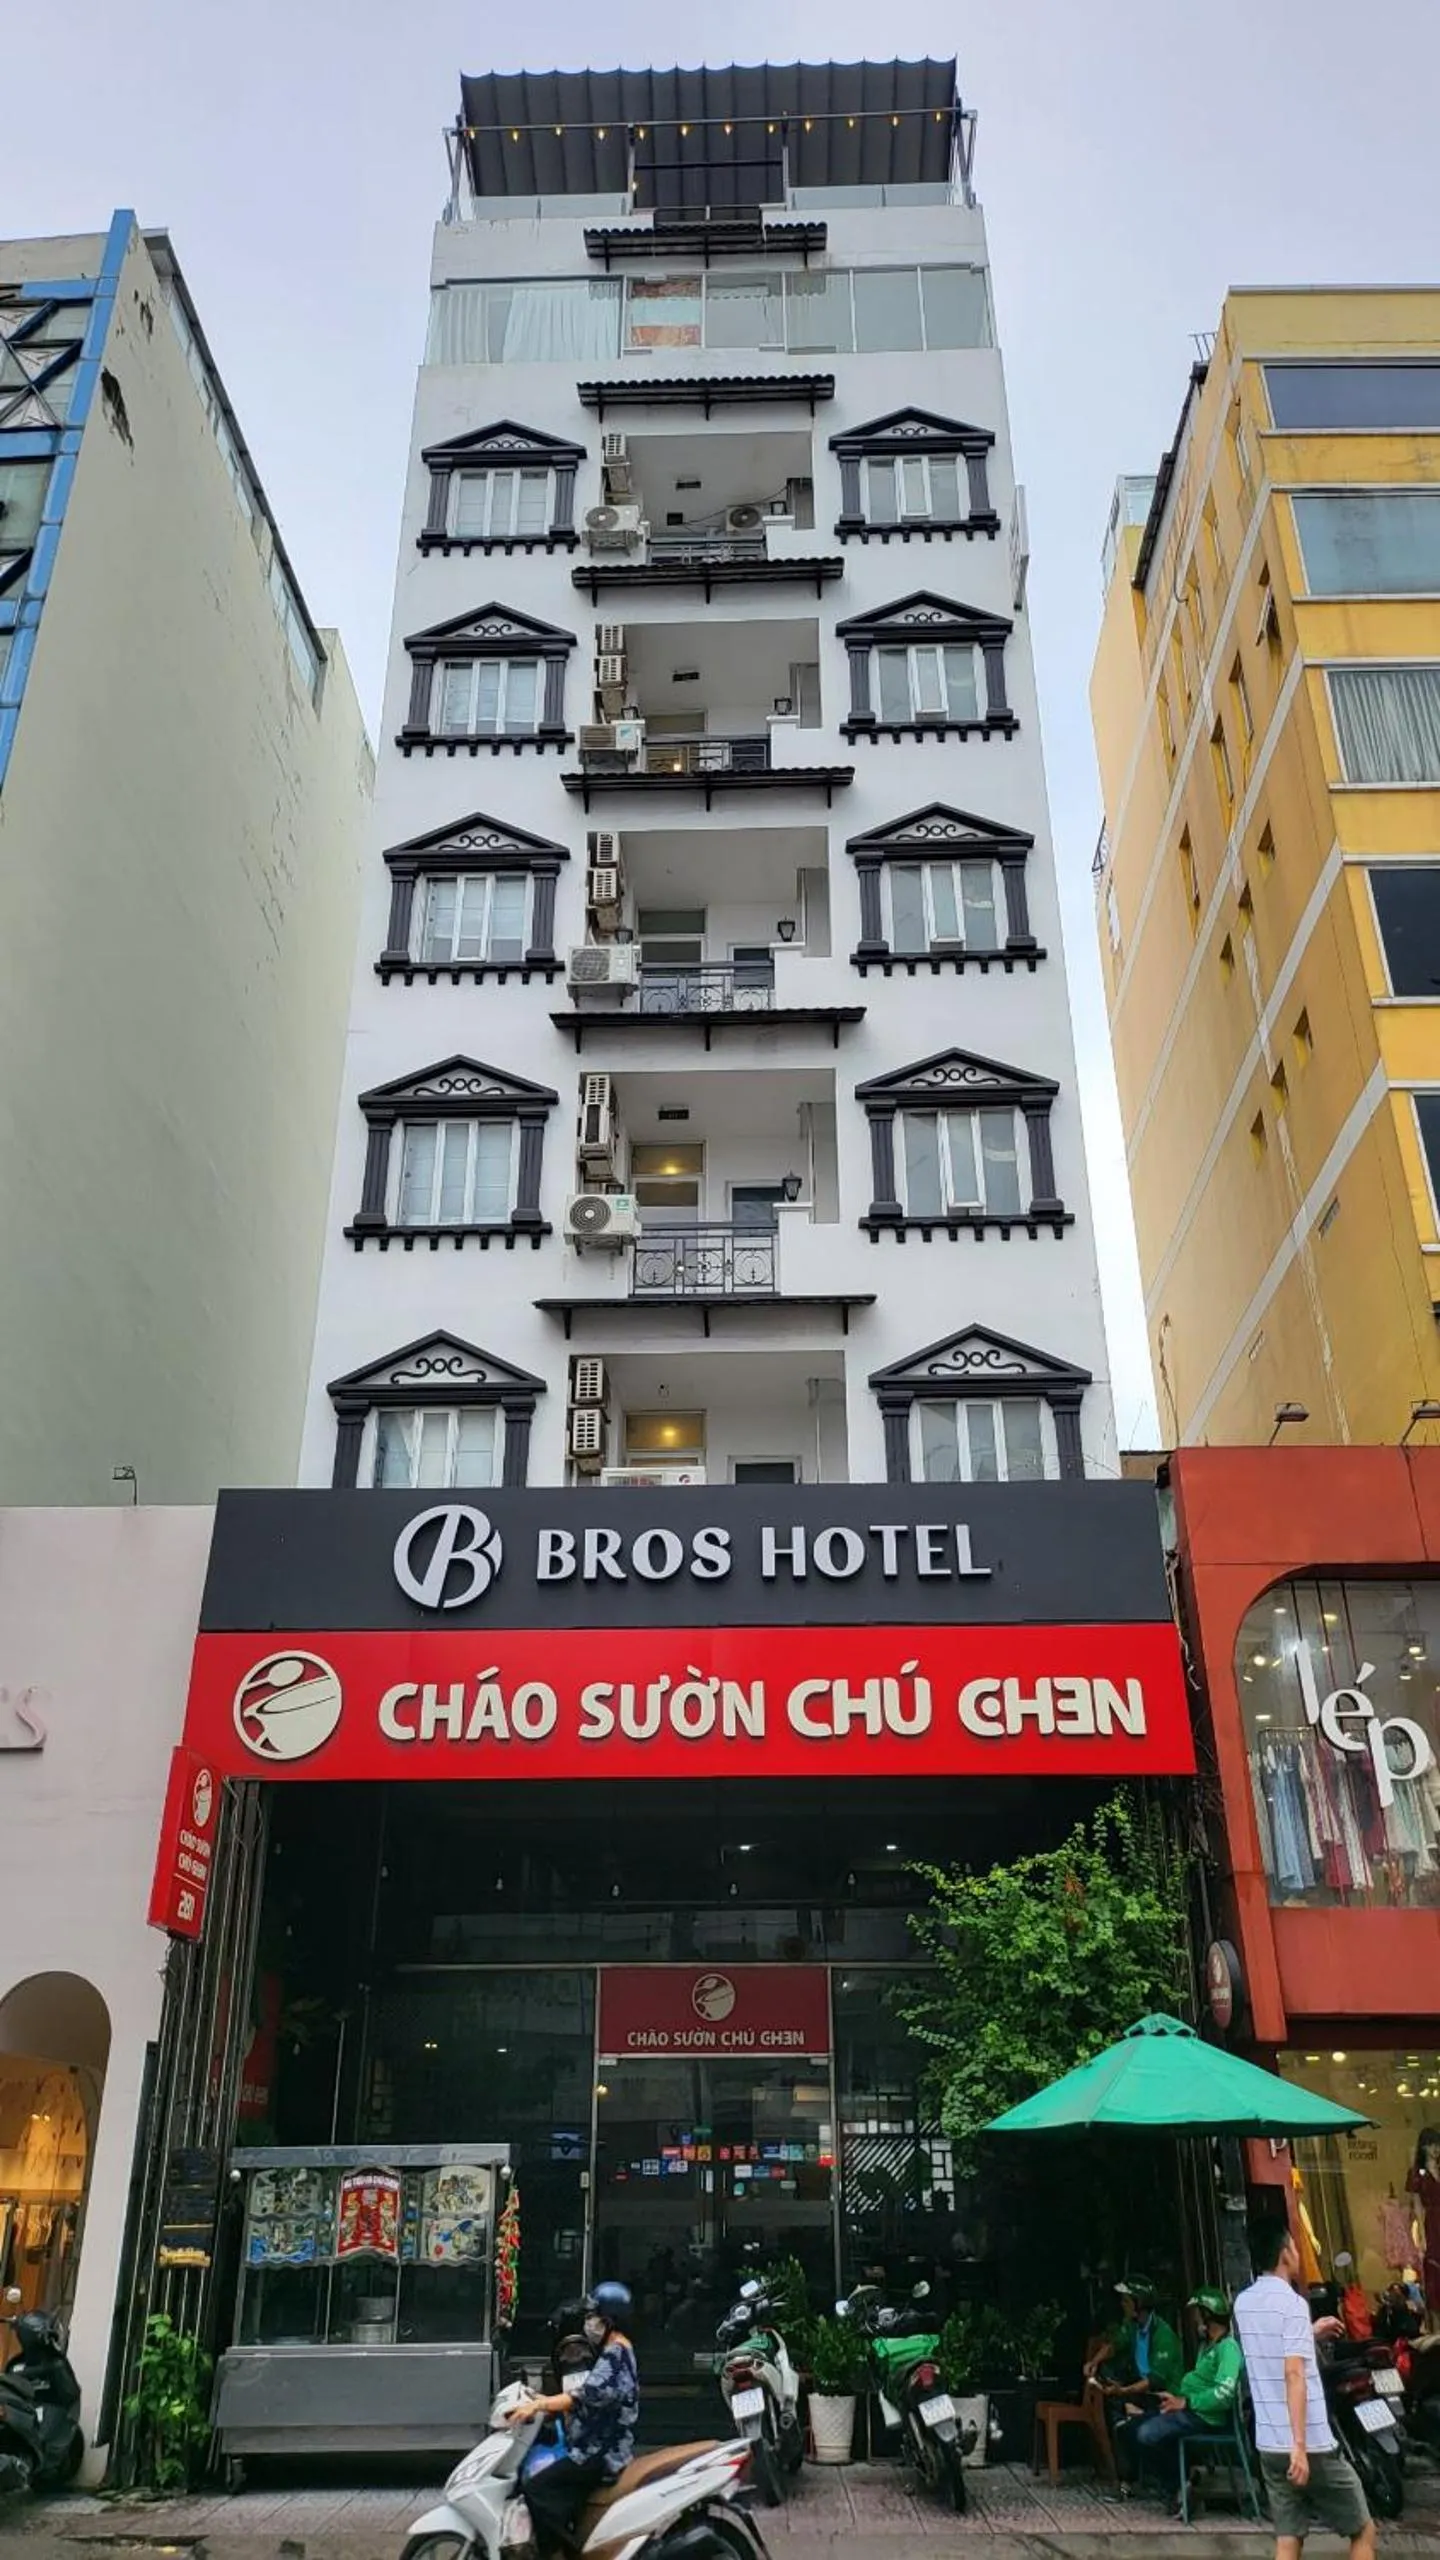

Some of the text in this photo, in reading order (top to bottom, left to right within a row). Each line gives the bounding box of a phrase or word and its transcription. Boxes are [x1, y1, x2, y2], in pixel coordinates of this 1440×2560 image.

[536, 1523, 993, 1582] BROS HOTEL
[378, 1665, 559, 1742] CHÁO
[577, 1663, 766, 1741] SƯỜN
[786, 1659, 933, 1739] CHÚ
[1280, 1636, 1434, 1808] lép
